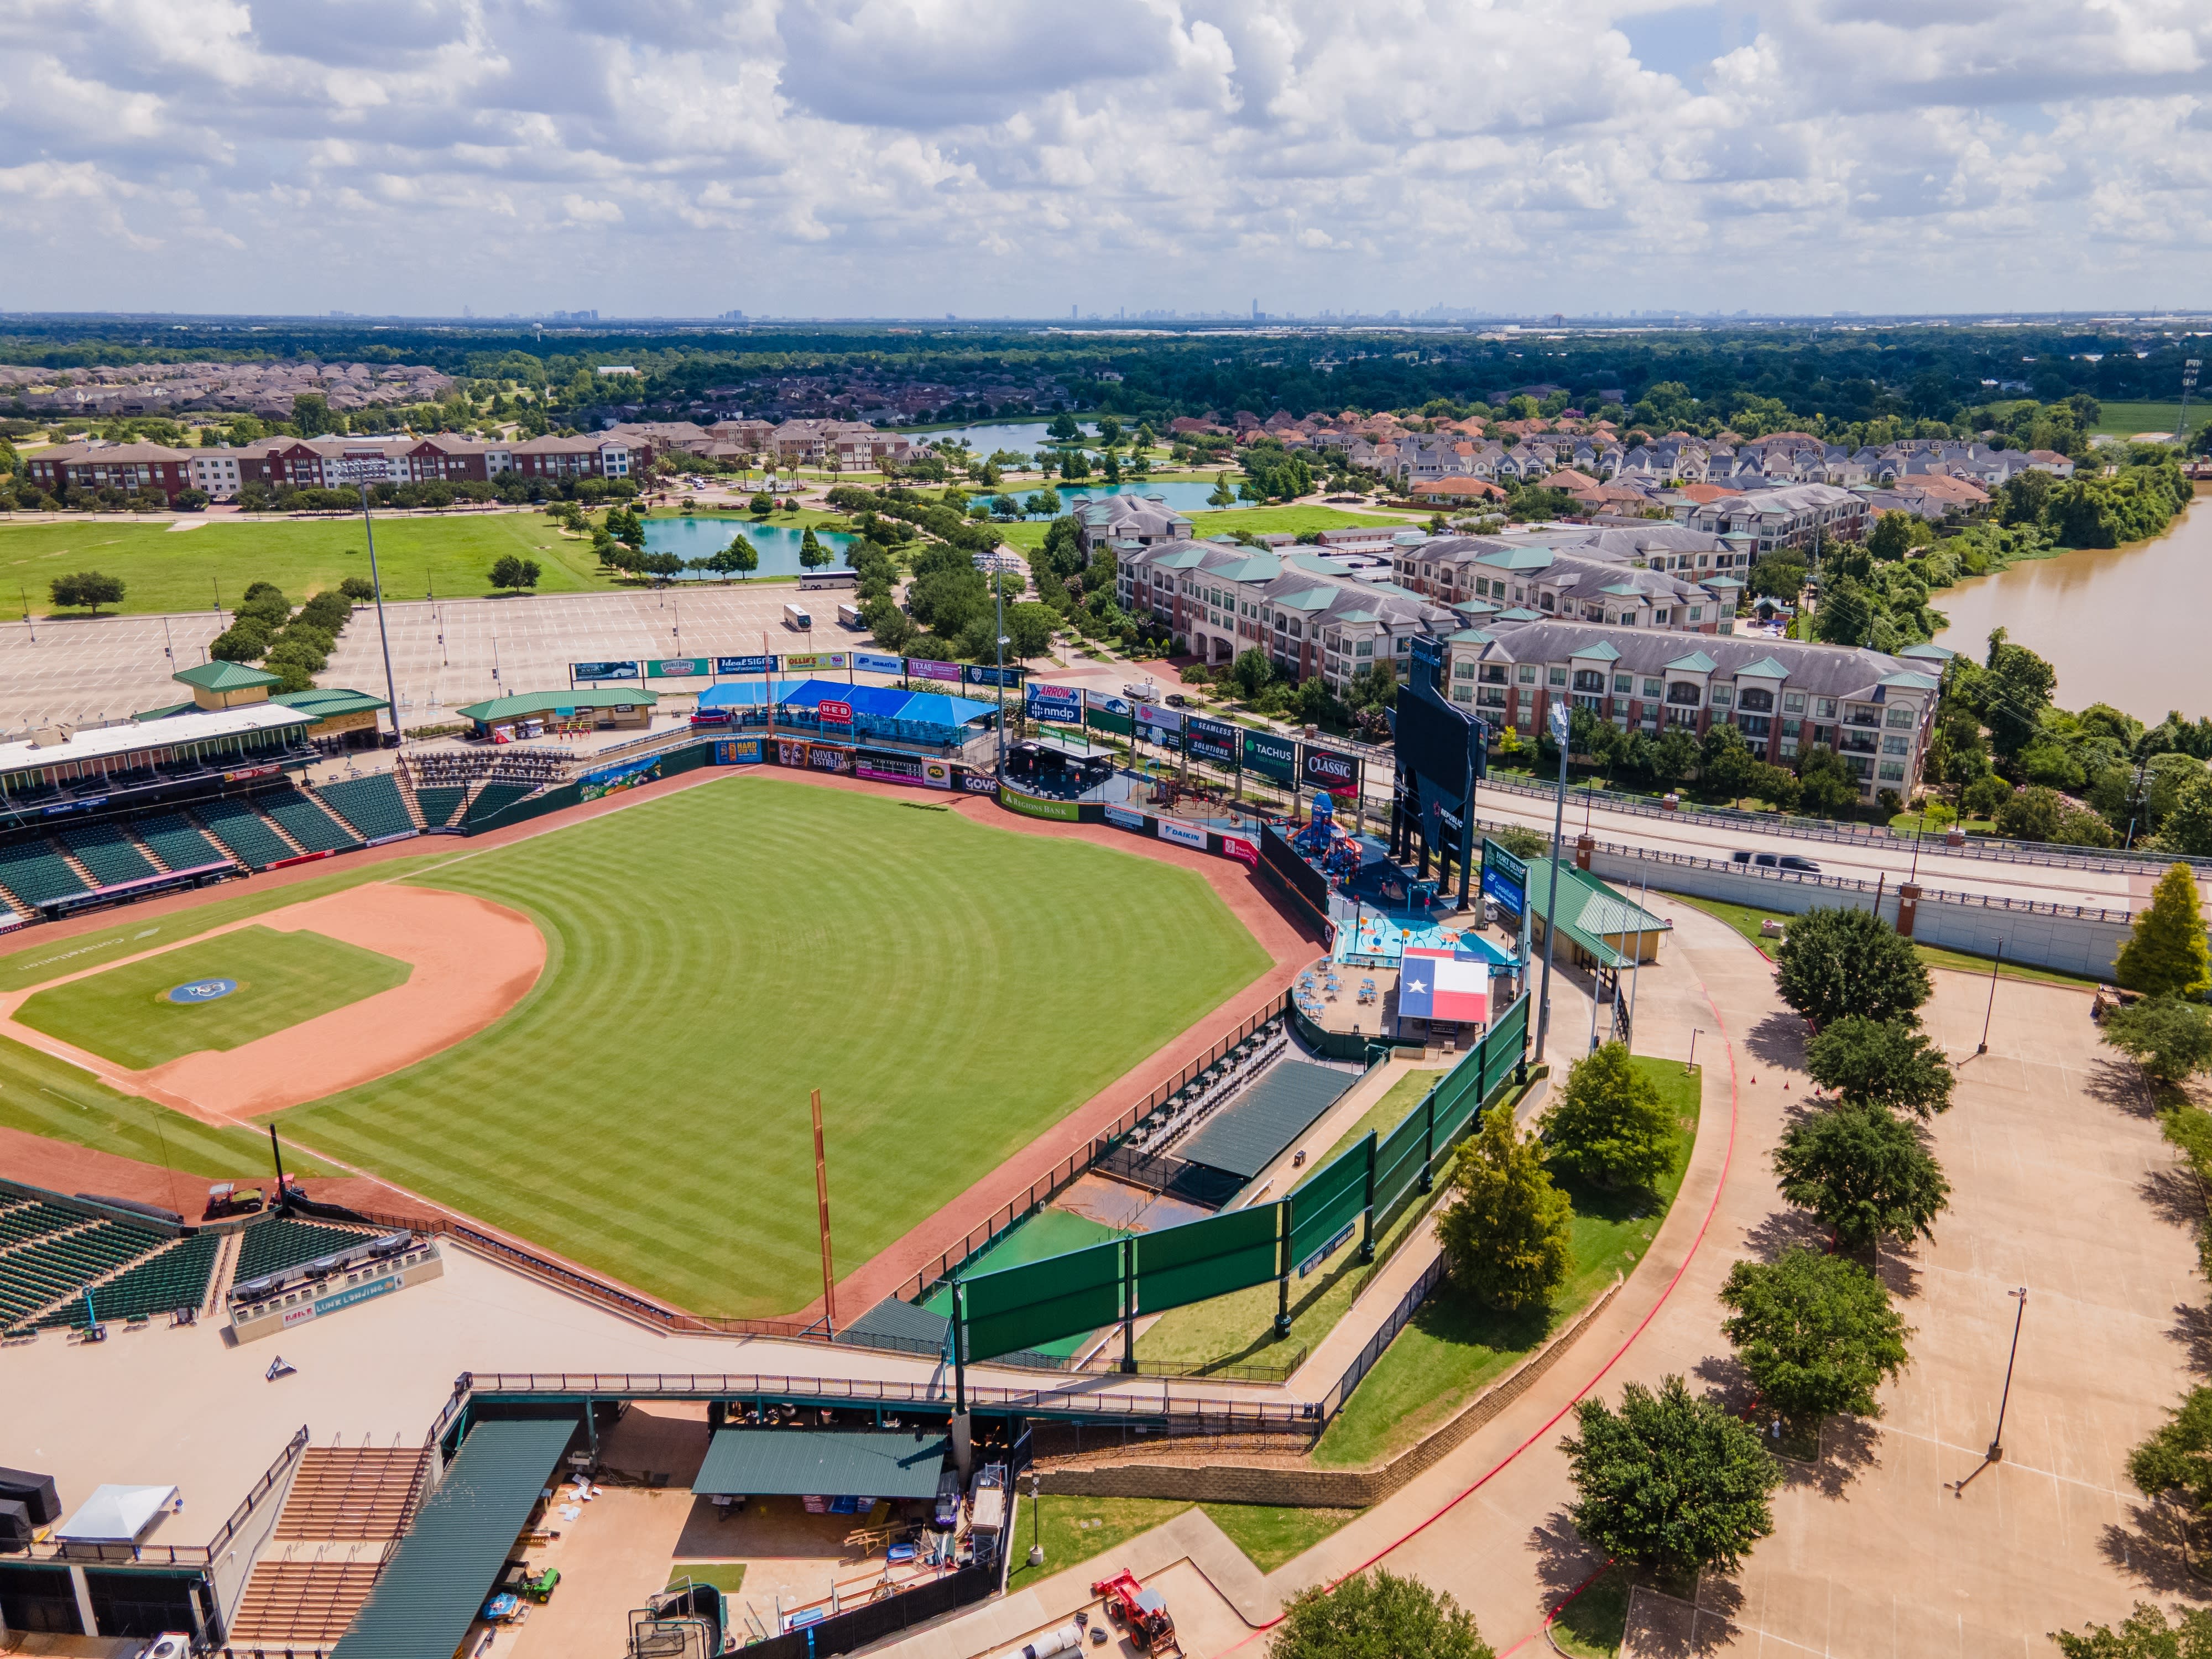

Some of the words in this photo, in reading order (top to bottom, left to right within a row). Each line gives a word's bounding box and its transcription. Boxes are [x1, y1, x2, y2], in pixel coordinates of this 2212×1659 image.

[911, 661, 932, 671] TEXAS
[1040, 686, 1072, 698] ARROW
[1044, 707, 1074, 721] nmdp
[1198, 722, 1232, 736] SEAMLESS
[1193, 741, 1228, 756] SOLUTIONS
[1256, 743, 1292, 760] TACHUS
[813, 757, 850, 769] ESTRELLA!
[833, 752, 843, 761] TU
[1308, 756, 1350, 778] CLASSIC
[1014, 797, 1042, 812] REGIONS
[1044, 805, 1067, 815] BANK
[1441, 808, 1463, 828] REPUBLIC
[1172, 830, 1199, 841] DAIKIN
[1496, 851, 1510, 865] FORT
[1510, 860, 1524, 874] BEND
